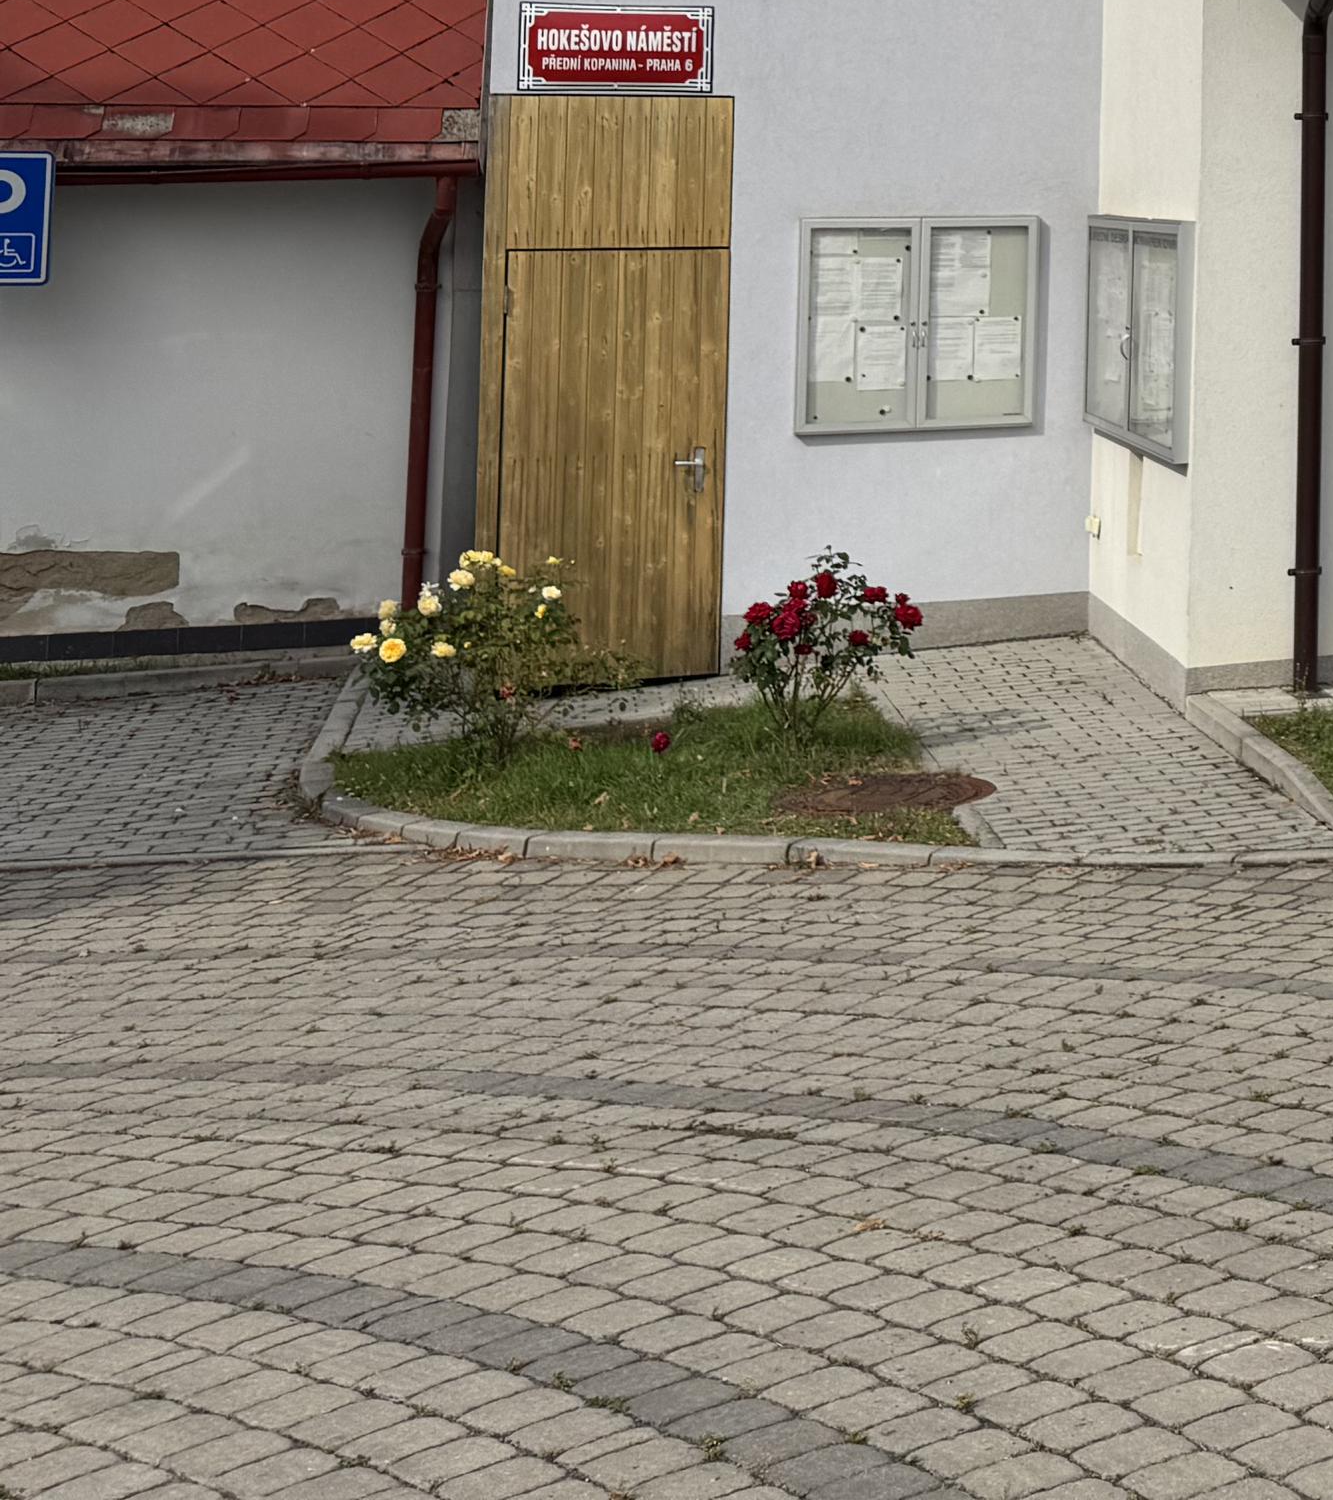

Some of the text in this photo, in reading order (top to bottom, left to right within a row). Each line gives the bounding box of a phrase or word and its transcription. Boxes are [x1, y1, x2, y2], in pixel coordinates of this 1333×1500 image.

[537, 24, 698, 52] HOKEŠOVO NÁMĚSTÍ
[542, 54, 582, 70] PŘEDNÍ
[584, 56, 637, 71] KOPANINA
[646, 58, 681, 72] PRAHA
[685, 59, 693, 72] 6
